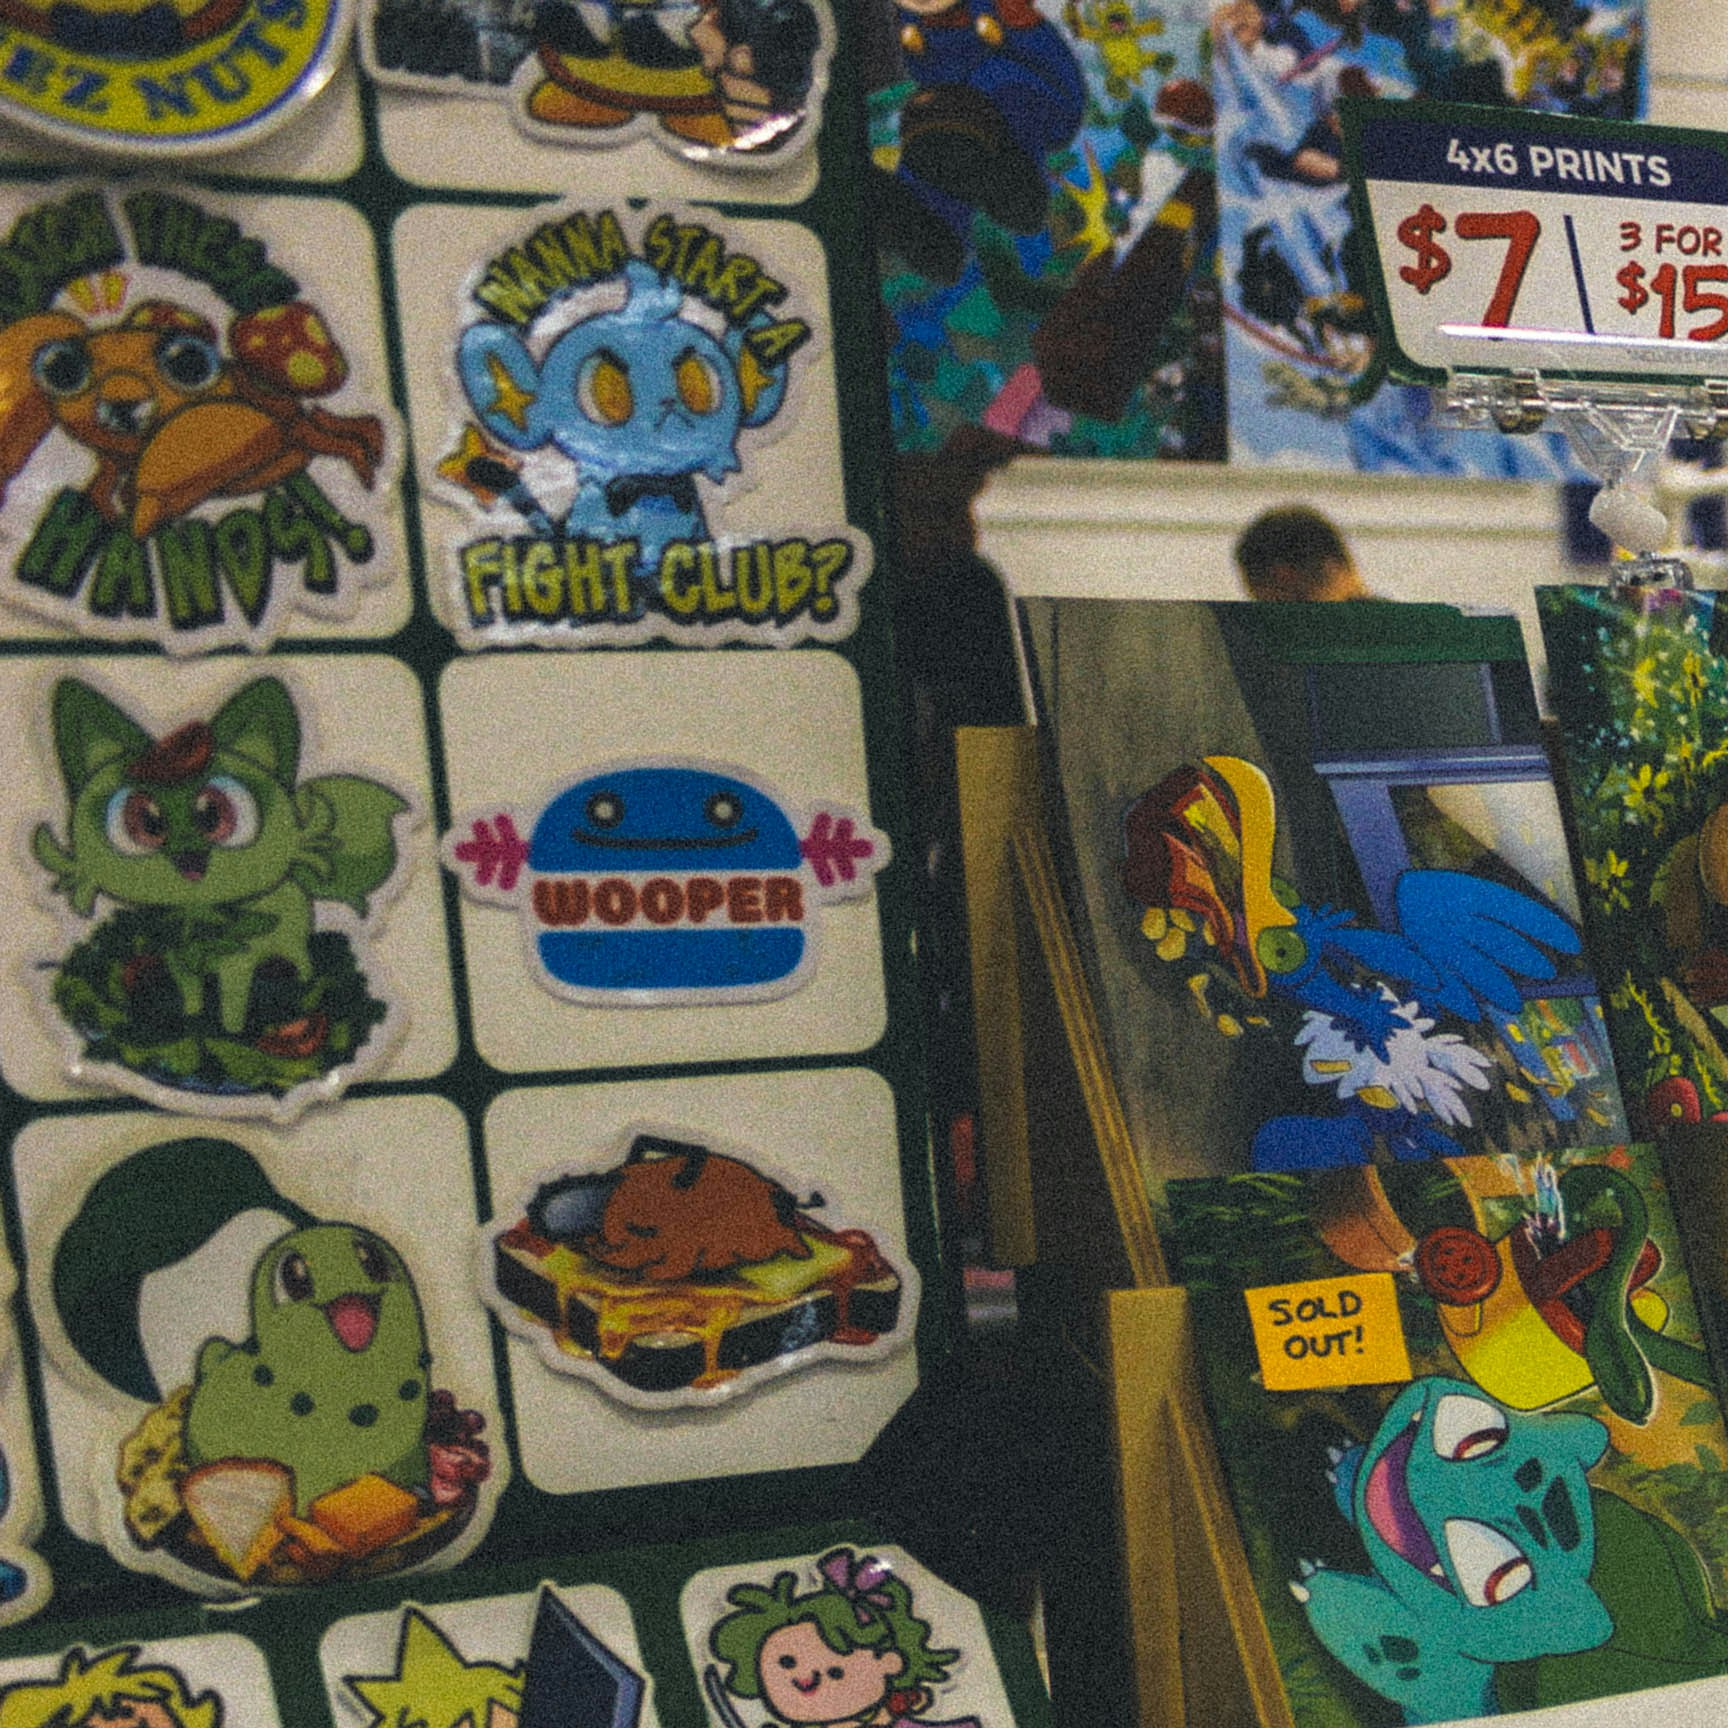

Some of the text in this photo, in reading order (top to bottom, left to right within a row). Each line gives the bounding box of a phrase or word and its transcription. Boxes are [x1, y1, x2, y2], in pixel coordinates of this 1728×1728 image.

[2, 44, 112, 113] EZ
[1447, 136, 1673, 188] 4x6 PRINTS
[1618, 220, 1724, 258] 3 FOR
[473, 209, 812, 369] WANNA START A
[1397, 202, 1542, 340] $7
[460, 533, 856, 630] FIGHT CLUB?
[532, 876, 804, 928] WOOPER
[1266, 1290, 1363, 1327] SOLD
[1282, 1327, 1368, 1360] OUT!
